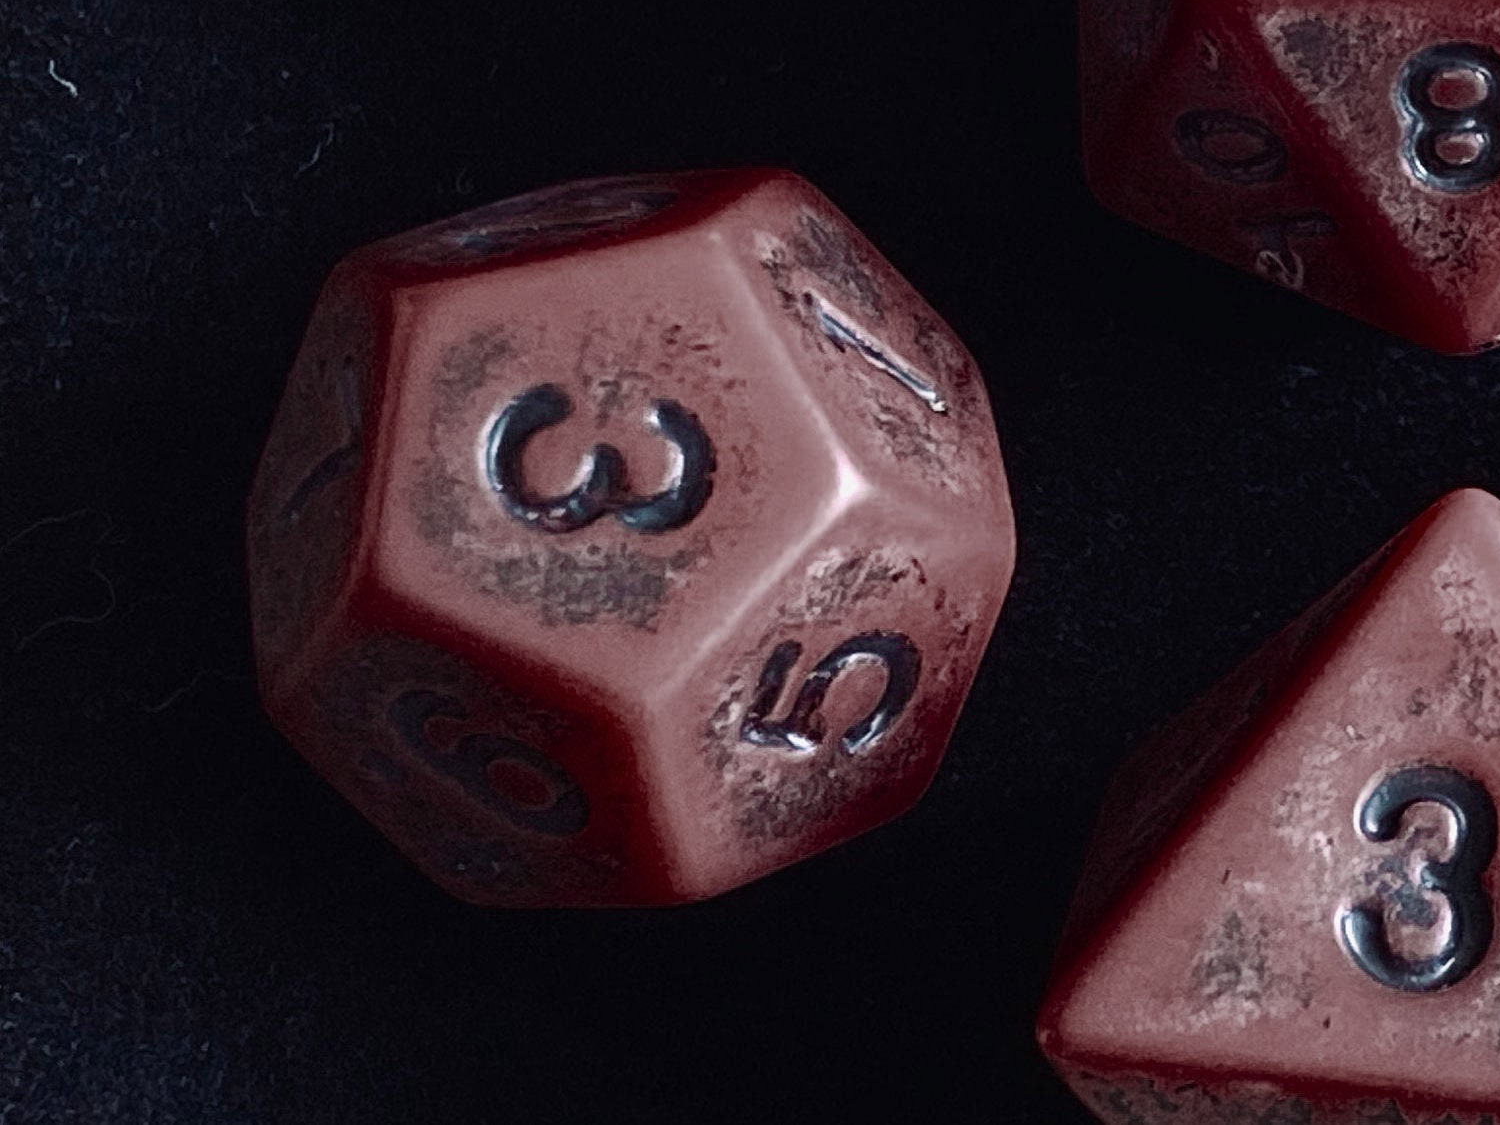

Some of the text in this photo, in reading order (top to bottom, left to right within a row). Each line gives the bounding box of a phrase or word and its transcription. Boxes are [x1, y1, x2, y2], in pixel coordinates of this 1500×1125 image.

[481, 381, 718, 533] 3
[736, 630, 923, 760] 5
[1333, 761, 1500, 994] 3
